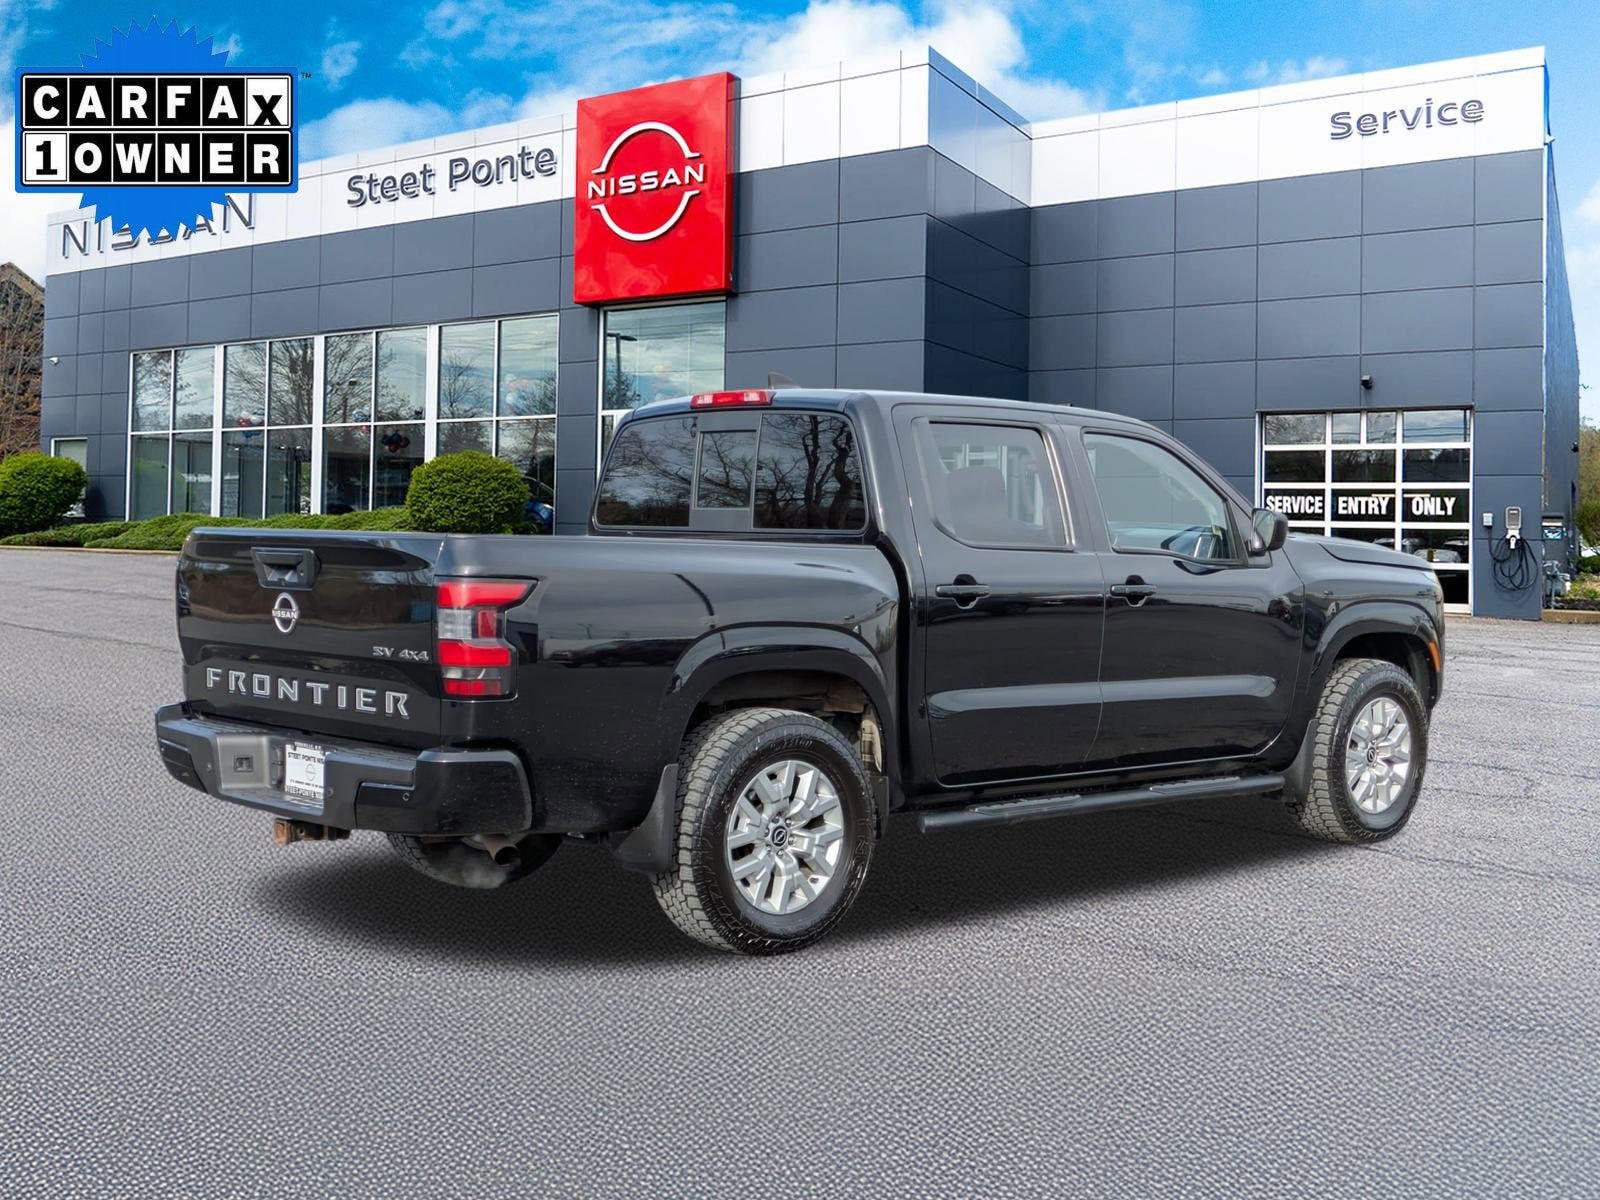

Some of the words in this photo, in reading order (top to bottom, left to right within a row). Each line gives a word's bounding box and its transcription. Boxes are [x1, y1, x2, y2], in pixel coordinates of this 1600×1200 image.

[1330, 98, 1485, 140] Service
[347, 163, 436, 207] Steet
[449, 146, 558, 191] Ponte
[587, 162, 705, 200] NISSAN
[62, 193, 256, 259] NIN
[1266, 495, 1323, 514] SERVICE
[1338, 496, 1389, 515] ENTRY
[1411, 496, 1457, 516] ONLY
[372, 646, 394, 658] SV
[399, 648, 429, 661] 4x4
[206, 667, 409, 716] FRONTIER
